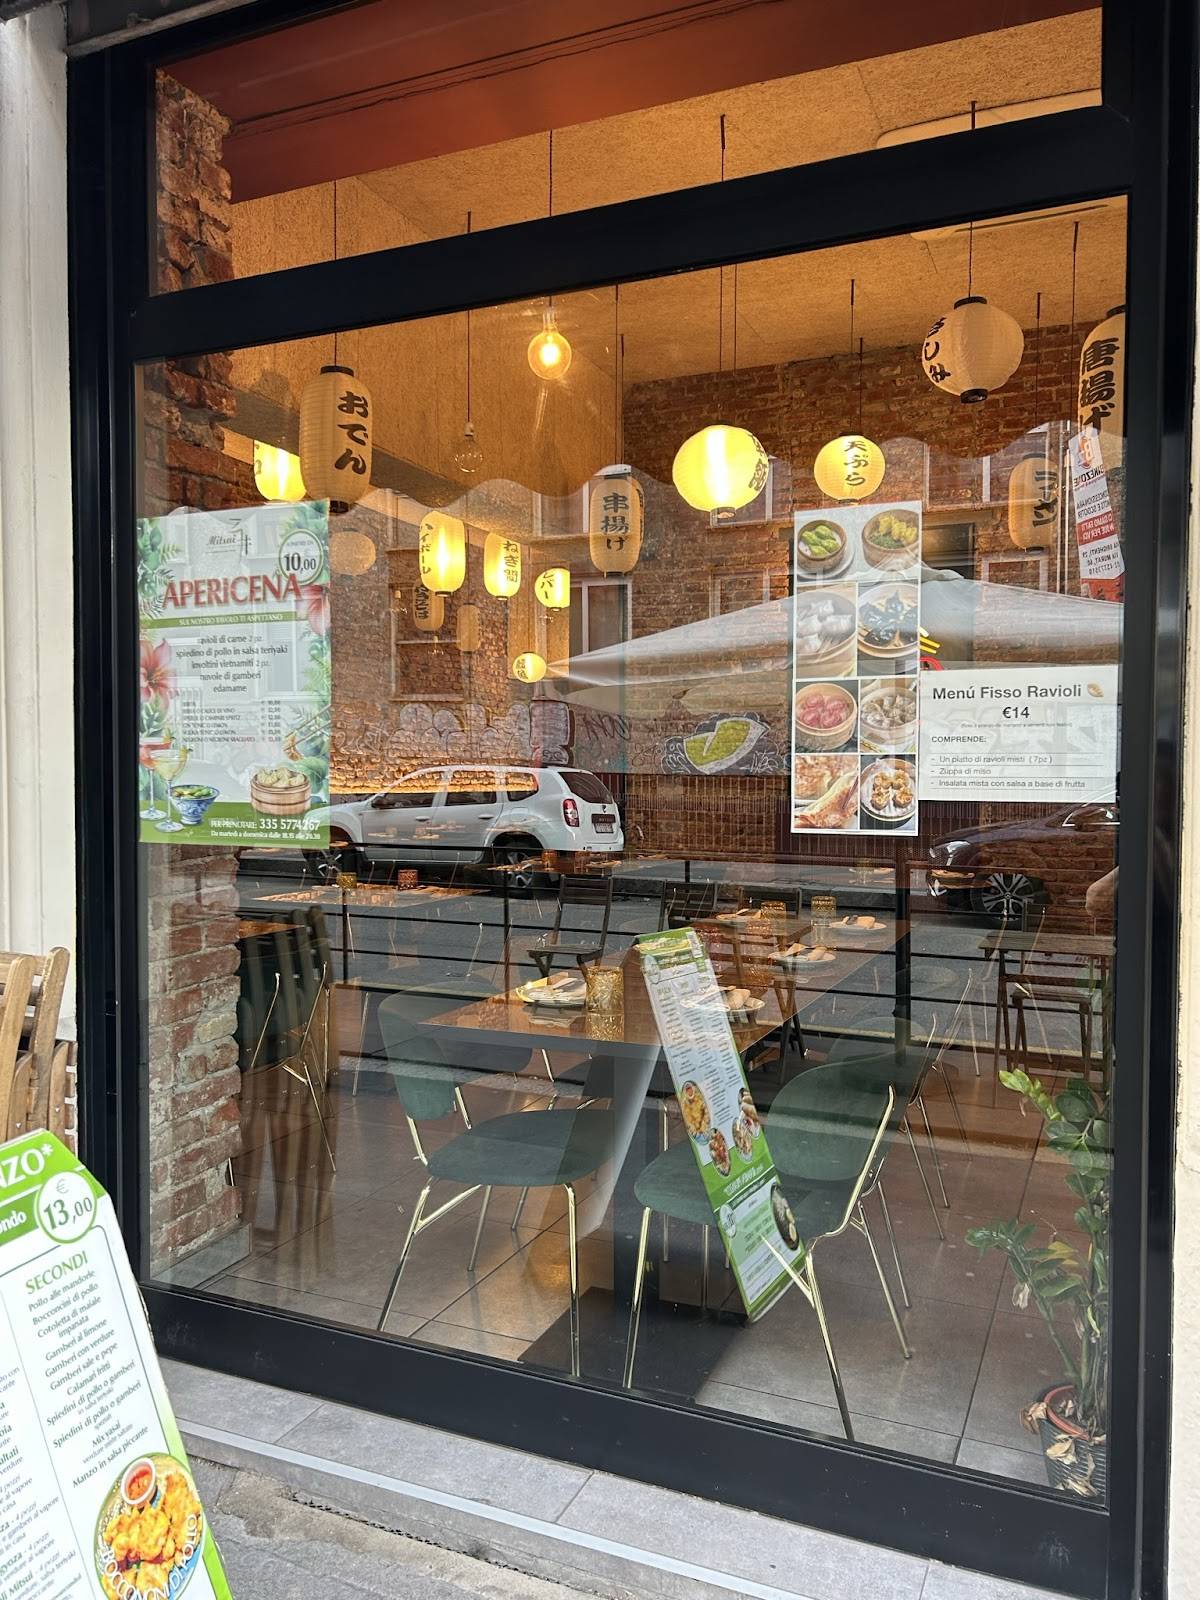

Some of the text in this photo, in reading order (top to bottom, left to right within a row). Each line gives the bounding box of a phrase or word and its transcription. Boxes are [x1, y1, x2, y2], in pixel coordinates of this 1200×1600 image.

[334, 390, 369, 475] おでん
[284, 552, 316, 574] 10,00
[162, 573, 301, 609] APERICENA
[219, 634, 226, 644] di
[176, 648, 205, 660] spiedino
[206, 647, 212, 656] di
[213, 646, 232, 658] pollo
[233, 646, 240, 654] in
[242, 645, 259, 654] salsa
[213, 684, 247, 693] edamame
[224, 671, 231, 680] di
[232, 670, 262, 682] gamberi
[933, 684, 1082, 700] Menú Fisso Ravioli
[1002, 706, 1030, 719] €14
[939, 768, 963, 776] Zuppa
[964, 767, 972, 775] di
[974, 755, 981, 763] di
[983, 755, 1005, 763] ravioli
[1007, 755, 1025, 763] misti
[939, 780, 967, 788] Insalata
[969, 780, 989, 788] mista
[1006, 780, 1026, 788] salsa
[1034, 780, 1053, 788] base
[1056, 780, 1063, 788] di
[1064, 780, 1086, 788] frutta
[259, 818, 278, 830] 335
[0, 1210, 27, 1233] ndo
[43, 1197, 93, 1230] 13,00
[25, 1250, 88, 1294] SECONDI
[28, 1269, 97, 1312] Pollo alle mandorle
[32, 1282, 99, 1326] Bocconcini di pollo
[37, 1295, 102, 1338] Cotoletta di maiale
[58, 1314, 90, 1338] impanata
[45, 1318, 108, 1362] Gamberi al limone
[45, 1328, 116, 1377] Gamberi con verdure
[50, 1366, 82, 1391] Gamberi
[83, 1357, 95, 1371] sale
[101, 1342, 118, 1360] pepe
[66, 1360, 112, 1396] Calamari fritti
[46, 1402, 77, 1427] Spiedini
[78, 1394, 86, 1406] di
[86, 1382, 103, 1403] pollo
[110, 1359, 136, 1384] gamberi
[53, 1422, 84, 1448] Spiedini
[84, 1416, 92, 1427] di
[93, 1403, 109, 1423] pollo
[116, 1380, 142, 1405] gamberi
[92, 1434, 105, 1448] Mix
[72, 1426, 149, 1488] Manzo in salsa piccante
[9, 1570, 34, 1596] Mitsui
